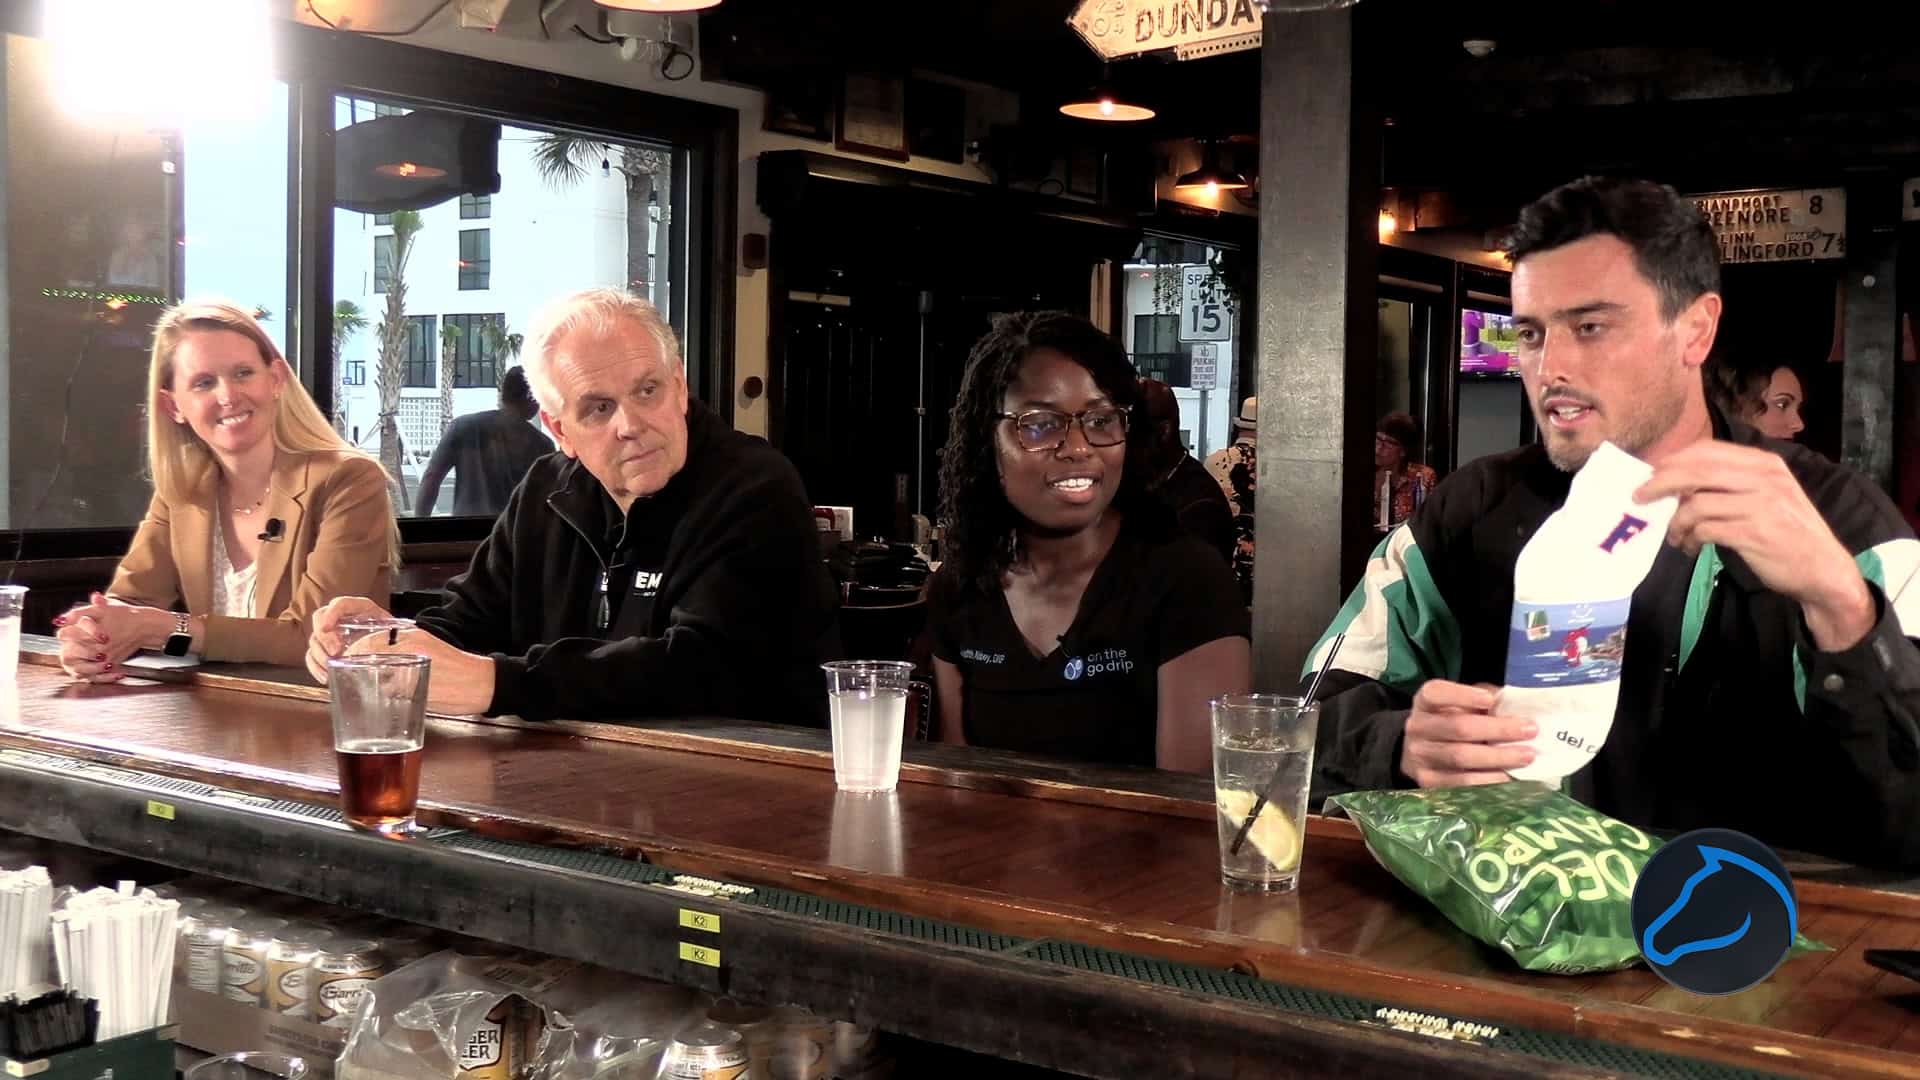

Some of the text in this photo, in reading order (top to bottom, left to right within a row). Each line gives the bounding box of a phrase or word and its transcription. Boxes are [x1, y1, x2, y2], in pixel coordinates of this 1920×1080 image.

[1809, 194, 1824, 216] 8
[1191, 304, 1221, 333] 15
[1599, 512, 1649, 554] F
[1087, 647, 1127, 664] on the
[1087, 657, 1134, 678] go drip
[1556, 730, 1585, 750] del
[1469, 815, 1651, 894] CAMPO
[1519, 848, 1638, 901] DEL
[693, 914, 705, 927] K2
[693, 949, 705, 961] K2
